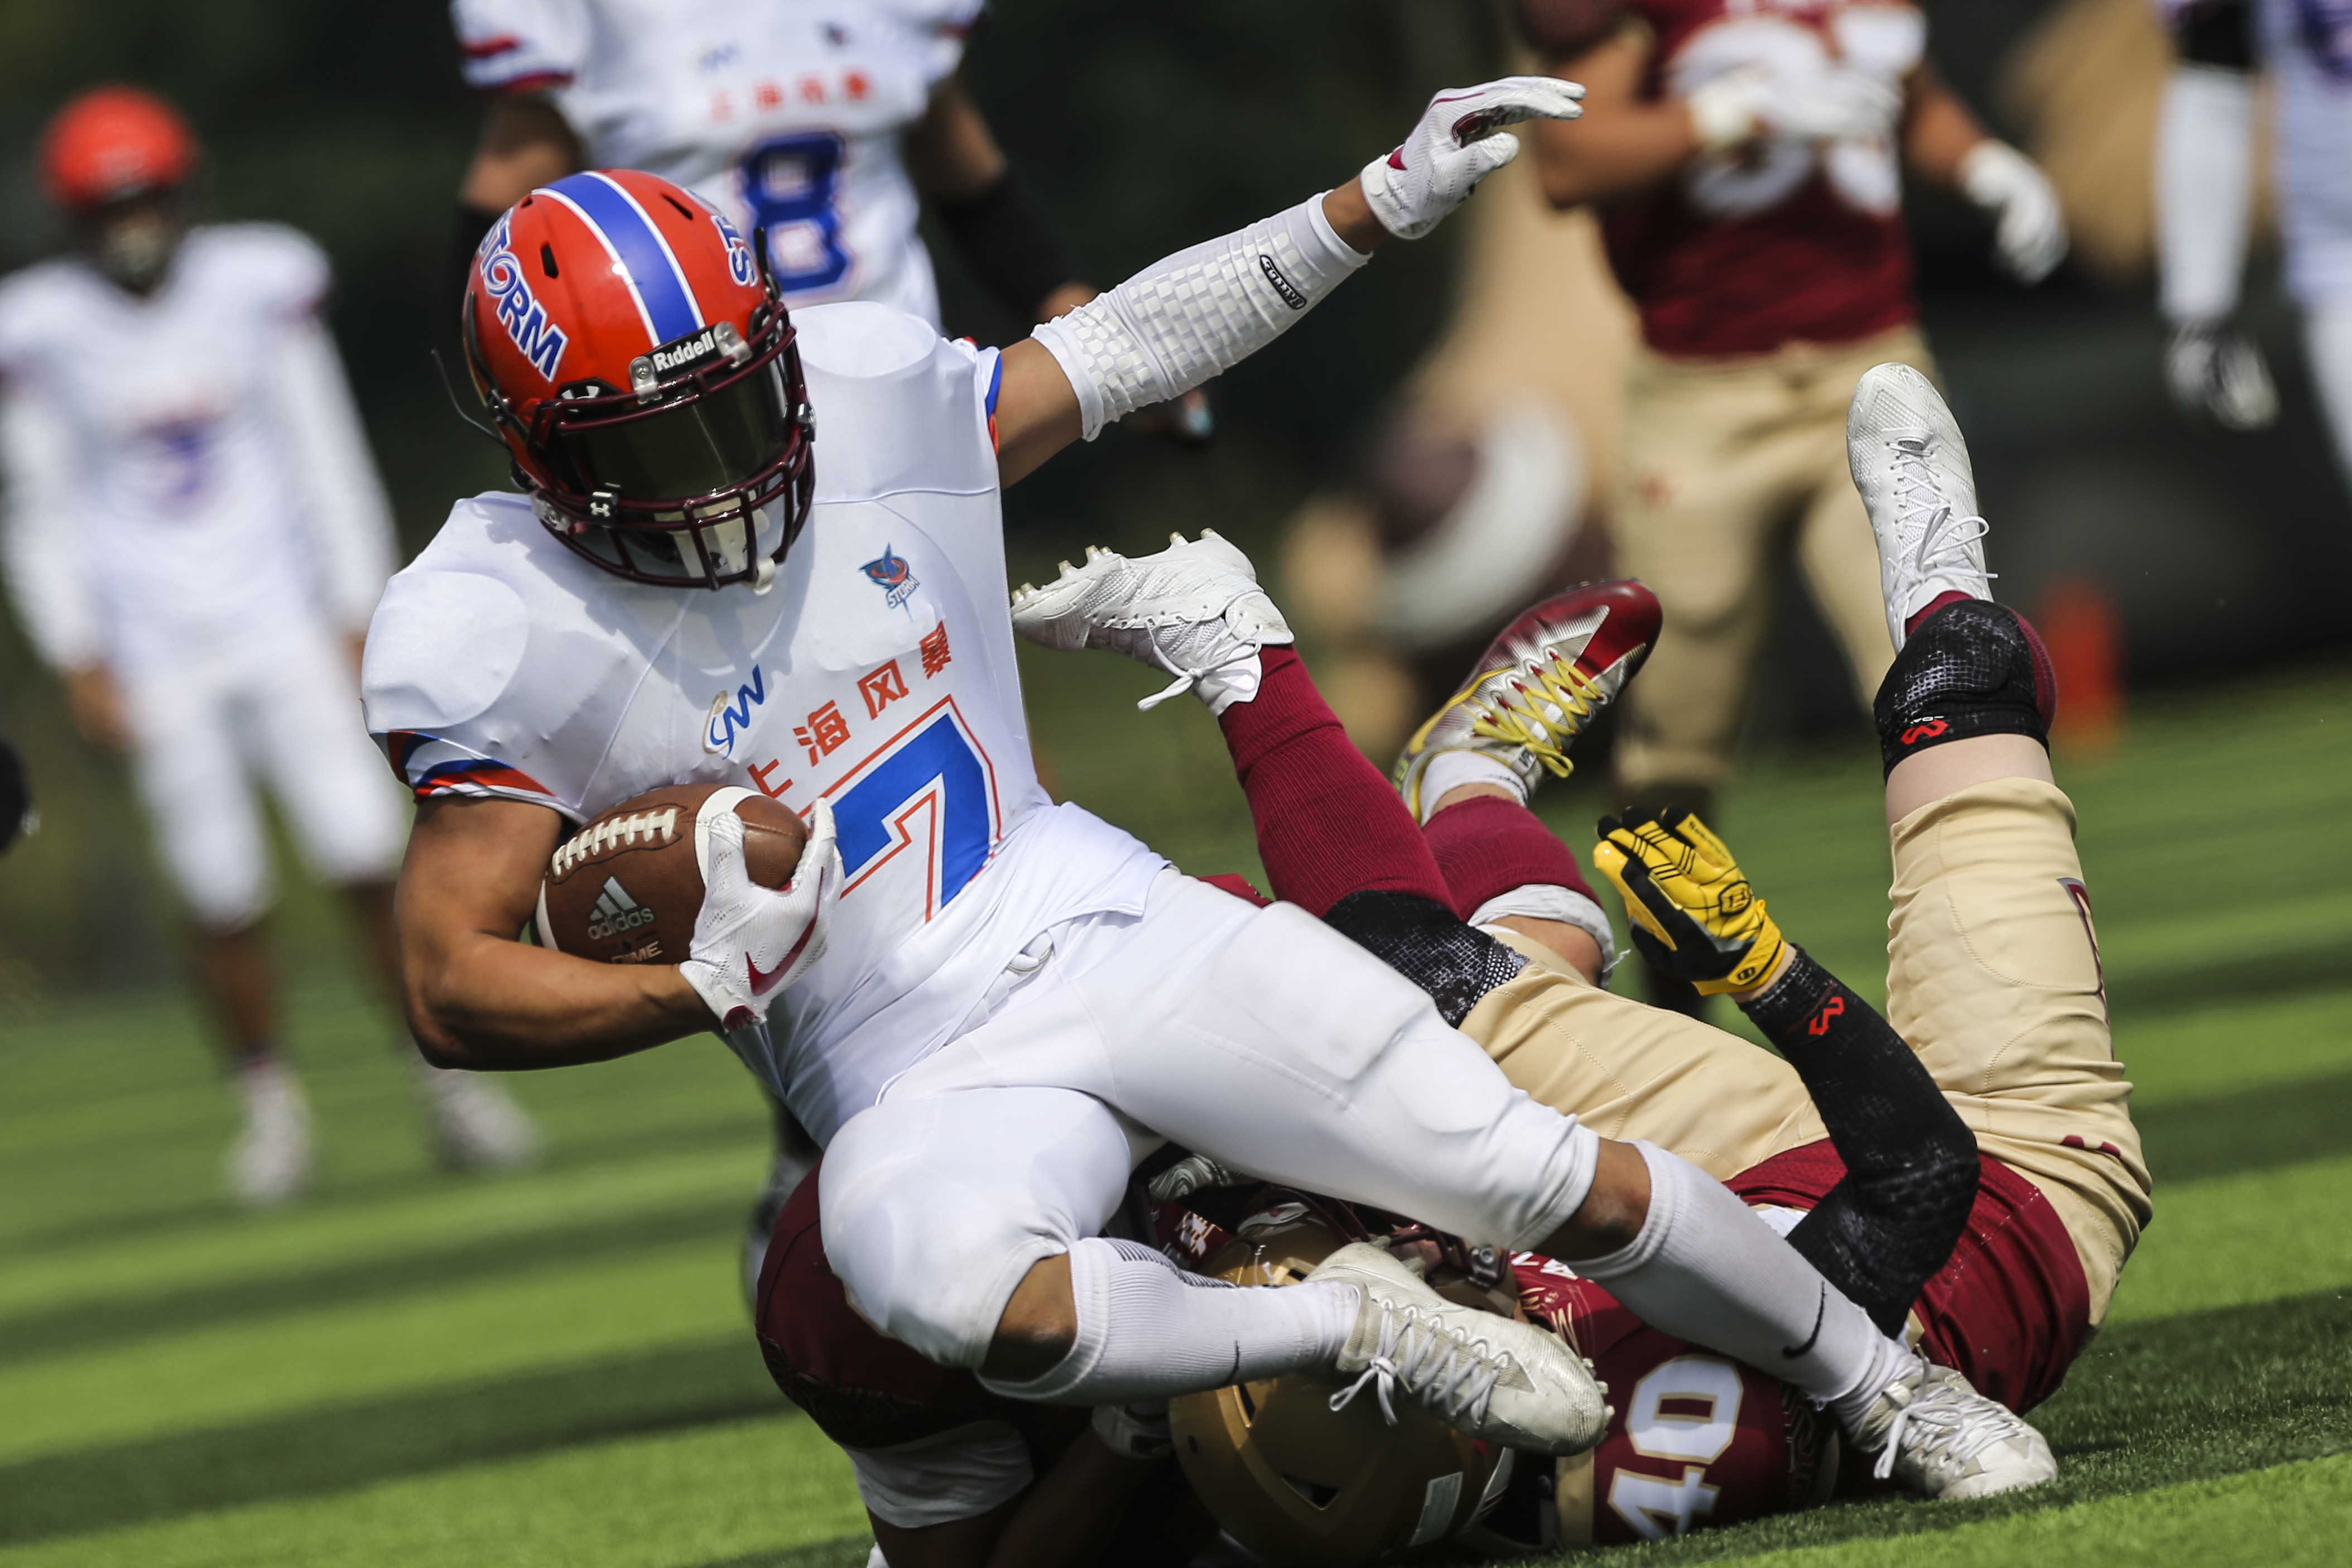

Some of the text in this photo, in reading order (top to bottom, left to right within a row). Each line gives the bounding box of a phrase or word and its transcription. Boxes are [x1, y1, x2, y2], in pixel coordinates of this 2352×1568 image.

[479, 207, 569, 383] STORM
[739, 128, 854, 295] 8
[1260, 258, 1305, 307] BATTLE
[652, 330, 715, 372] Riddell
[886, 574, 920, 608] STORM
[747, 620, 951, 799] 上海风暴
[801, 695, 1001, 922] 7
[588, 908, 655, 940] adidas
[1608, 1354, 1744, 1541] 40
